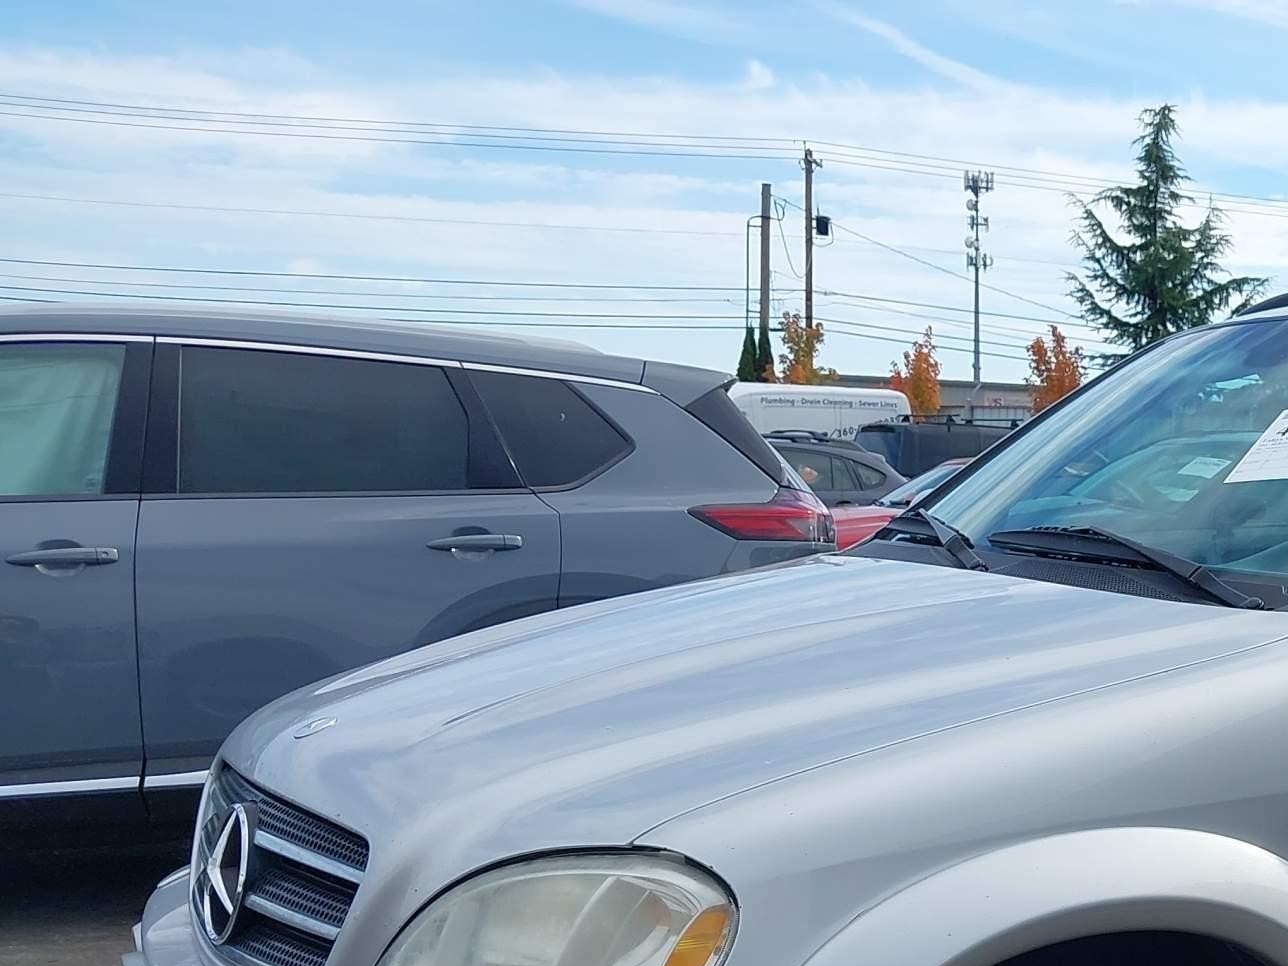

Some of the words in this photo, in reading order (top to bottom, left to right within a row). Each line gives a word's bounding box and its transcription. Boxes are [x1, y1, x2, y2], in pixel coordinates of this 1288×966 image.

[760, 397, 795, 407] Plumbing
[822, 398, 853, 408] Cleaning
[858, 400, 880, 408] Sewer
[880, 401, 898, 409] Lines
